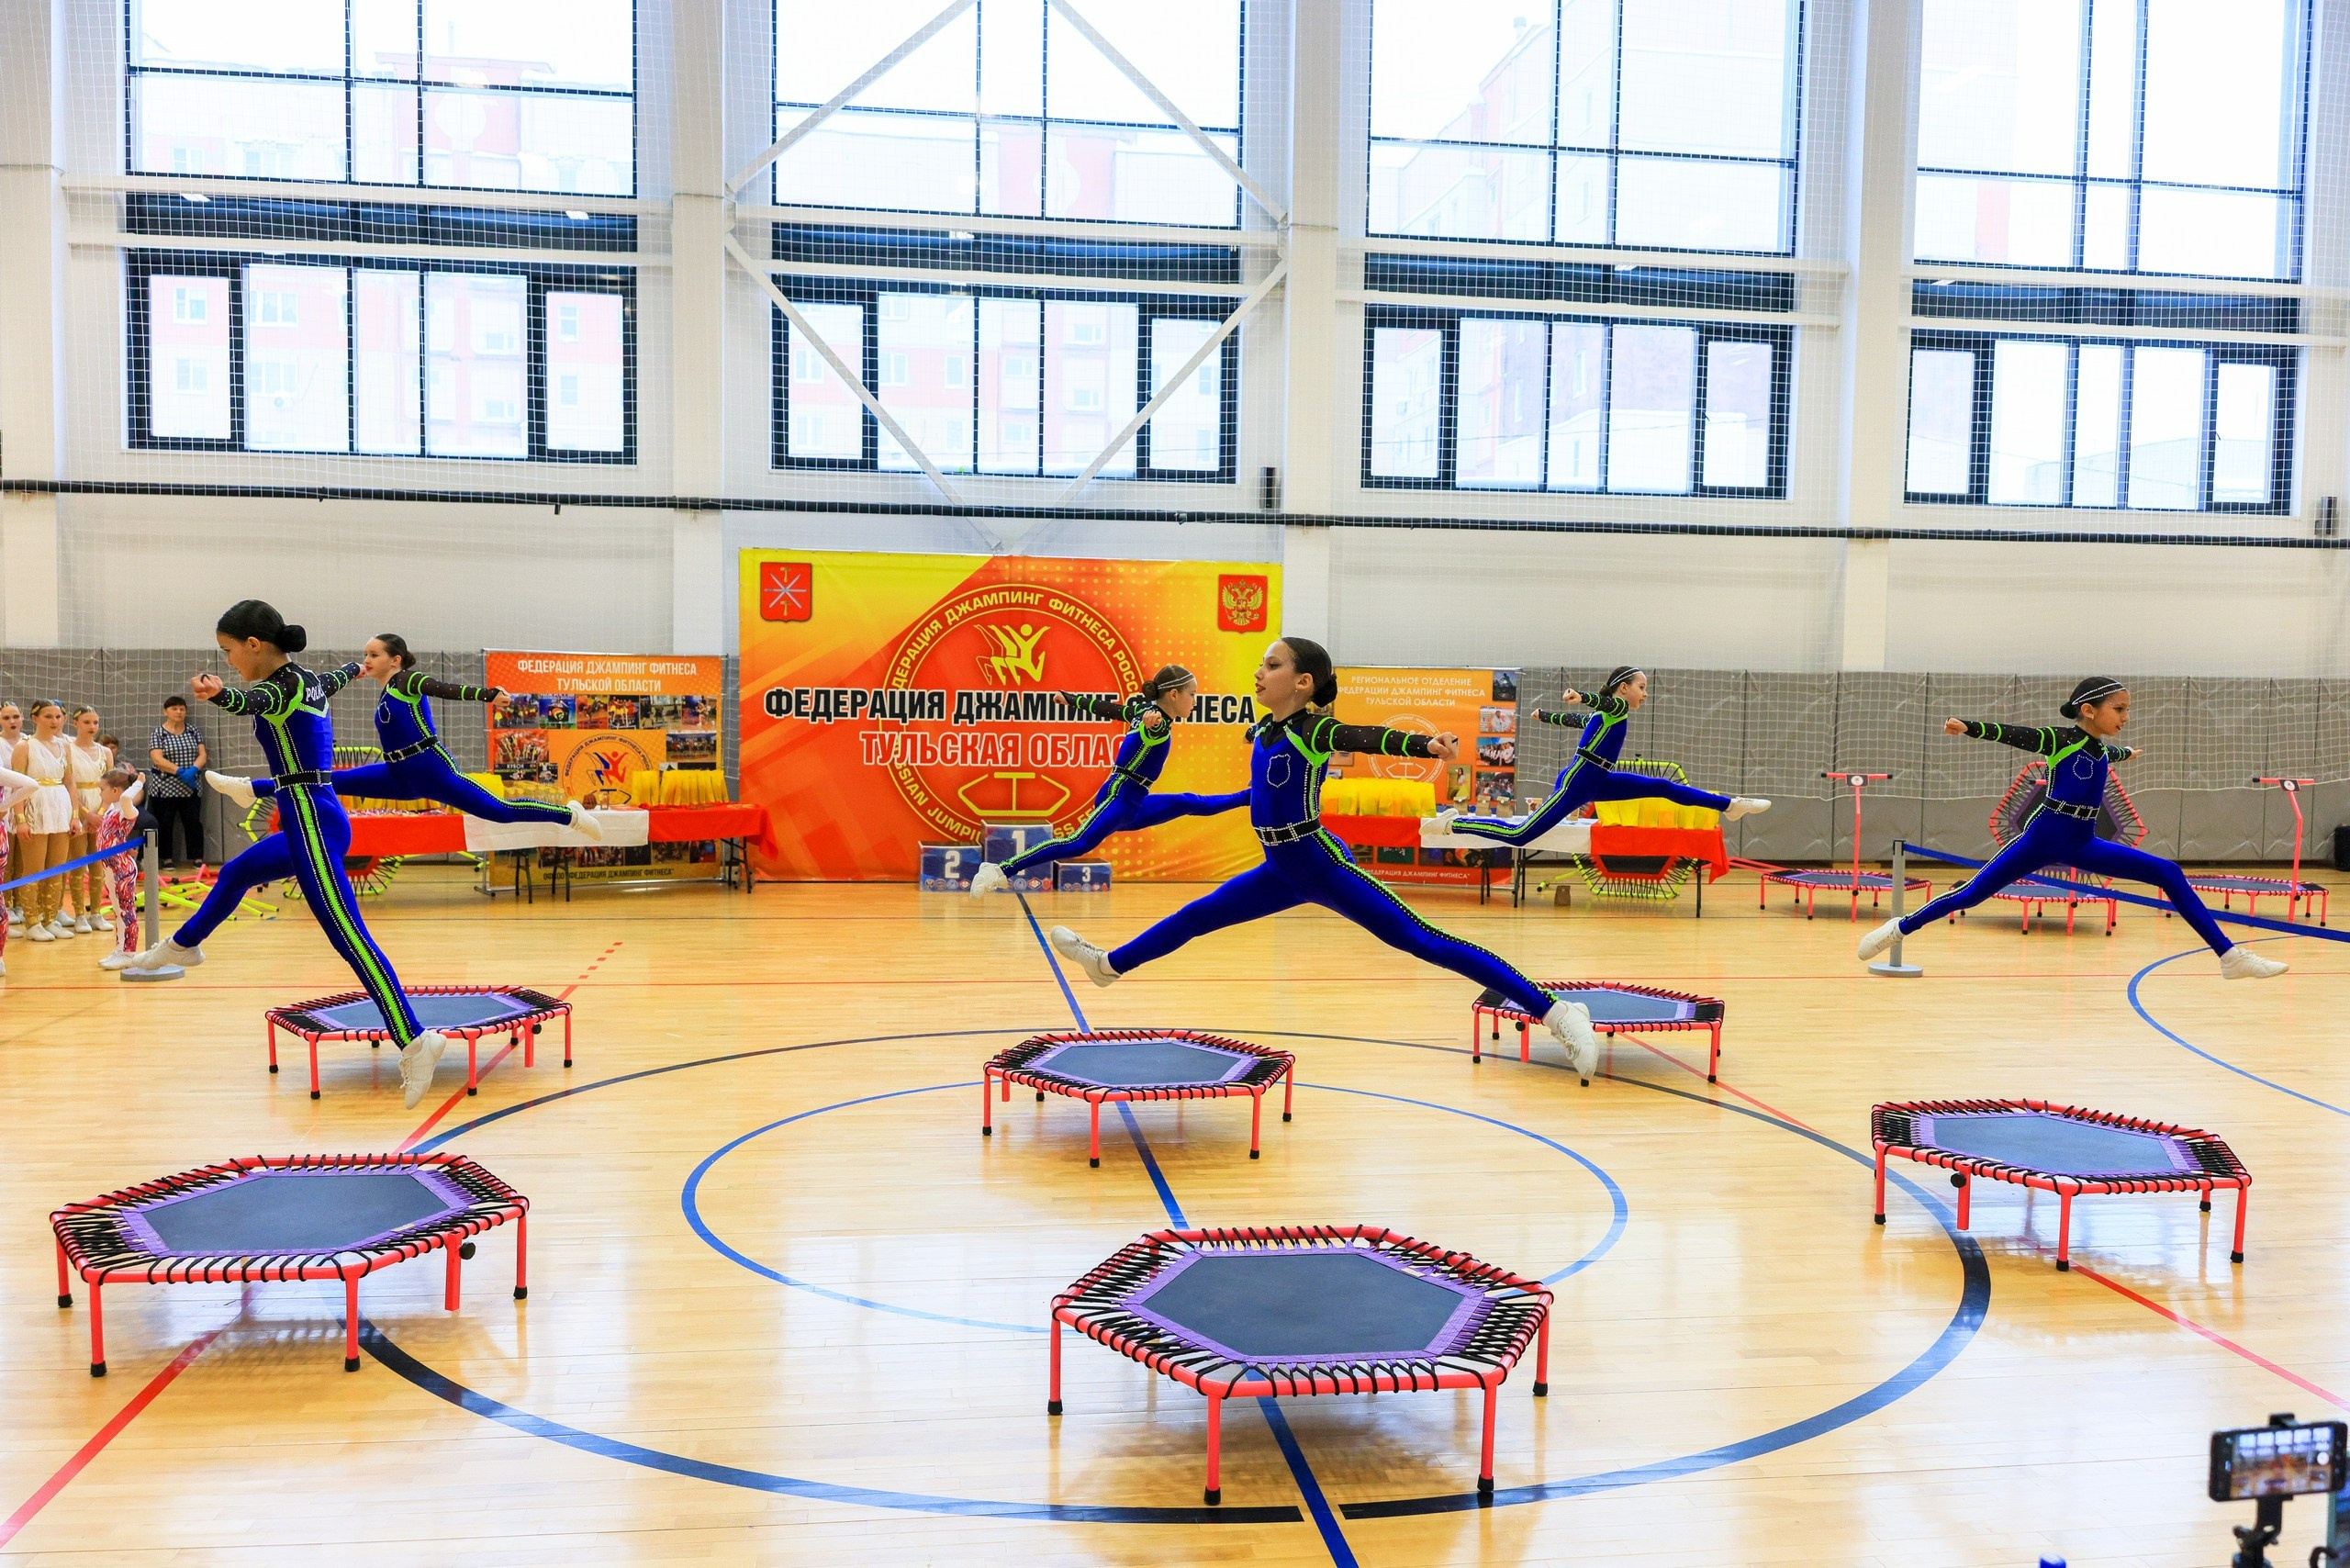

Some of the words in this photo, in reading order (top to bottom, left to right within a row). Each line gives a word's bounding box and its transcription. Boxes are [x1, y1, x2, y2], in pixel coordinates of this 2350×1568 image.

[891, 619, 944, 690] ДЕРАЦИЯ
[944, 591, 1045, 626] ДЖАМПИНГ
[1048, 598, 1116, 651] ФИТНЕСА
[1113, 650, 1138, 692] РОСС
[517, 659, 584, 674] ФЕДЕРАЦИЯ
[586, 660, 646, 676] ДЖАМПИНГ
[649, 662, 697, 676] ФИТНЕСА
[556, 677, 612, 691] ТУЛЬСКОЙ
[614, 678, 662, 692] ОБЛАСТИ
[1351, 676, 1419, 685] РЕГИОНАЛЬНОЕ
[1421, 678, 1472, 687] ОТДЕЛЕНИЕ
[1337, 686, 1389, 695] ФЕДЕРАЦИИ
[1391, 688, 1442, 696] ДЖАМПИНГ
[1445, 689, 1485, 698] ФИТНЕСА
[765, 687, 945, 724] ФЕДЕРАЦИЯ
[1366, 695, 1412, 706] ТУЛЬСКОЙ
[1414, 698, 1456, 707] ОБЛАСТИ
[584, 735, 618, 747] ДЖАМПИНГ
[619, 737, 642, 755] ФИТНЕСА
[641, 754, 651, 771] РОСС
[859, 731, 1022, 767] ТУЛЬСКАЯ
[1028, 733, 1126, 767] ОБЛАС
[926, 807, 980, 842] JUMPI
[945, 850, 960, 879] 2
[608, 868, 643, 879] ДЖАМПИНГ
[1081, 867, 1091, 882] 3
[1403, 870, 1438, 879] ДЖАМПИНГ
